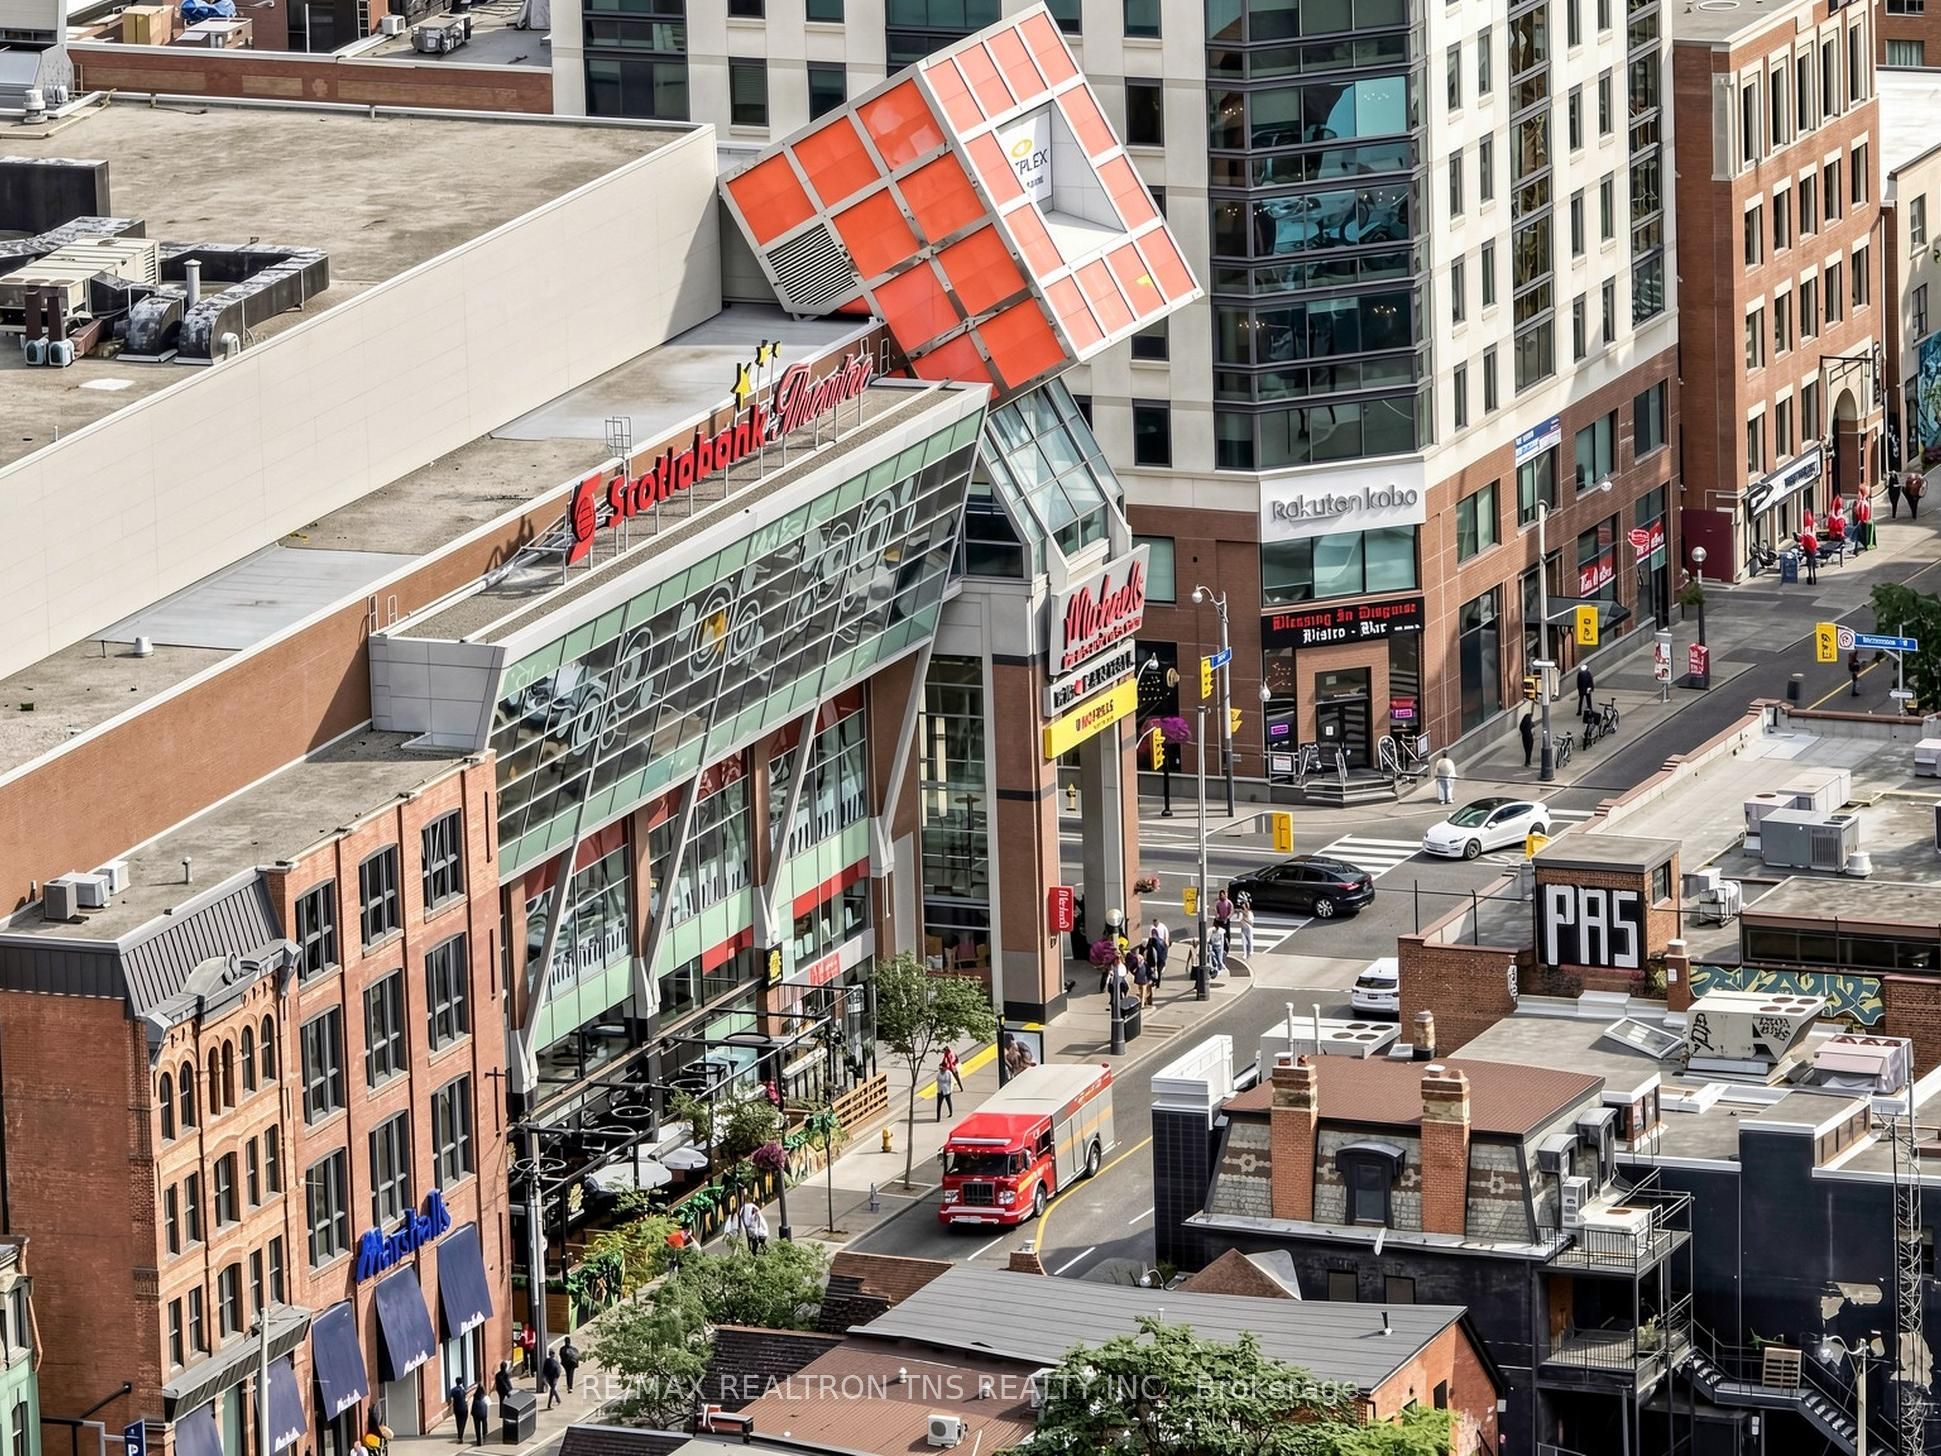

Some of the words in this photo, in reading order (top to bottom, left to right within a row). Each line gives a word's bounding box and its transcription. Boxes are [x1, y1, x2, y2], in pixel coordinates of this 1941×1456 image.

[607, 403, 768, 529] Scotiabank
[1272, 491, 1362, 522] Rakuten
[1366, 484, 1418, 510] kobo
[1271, 612, 1332, 632] Blessing
[1358, 602, 1417, 620] Disguise
[1302, 628, 1346, 644] Bistro
[1360, 621, 1388, 637] Bar
[1545, 883, 1638, 969] PAS
[356, 1187, 452, 1285] Marshalls
